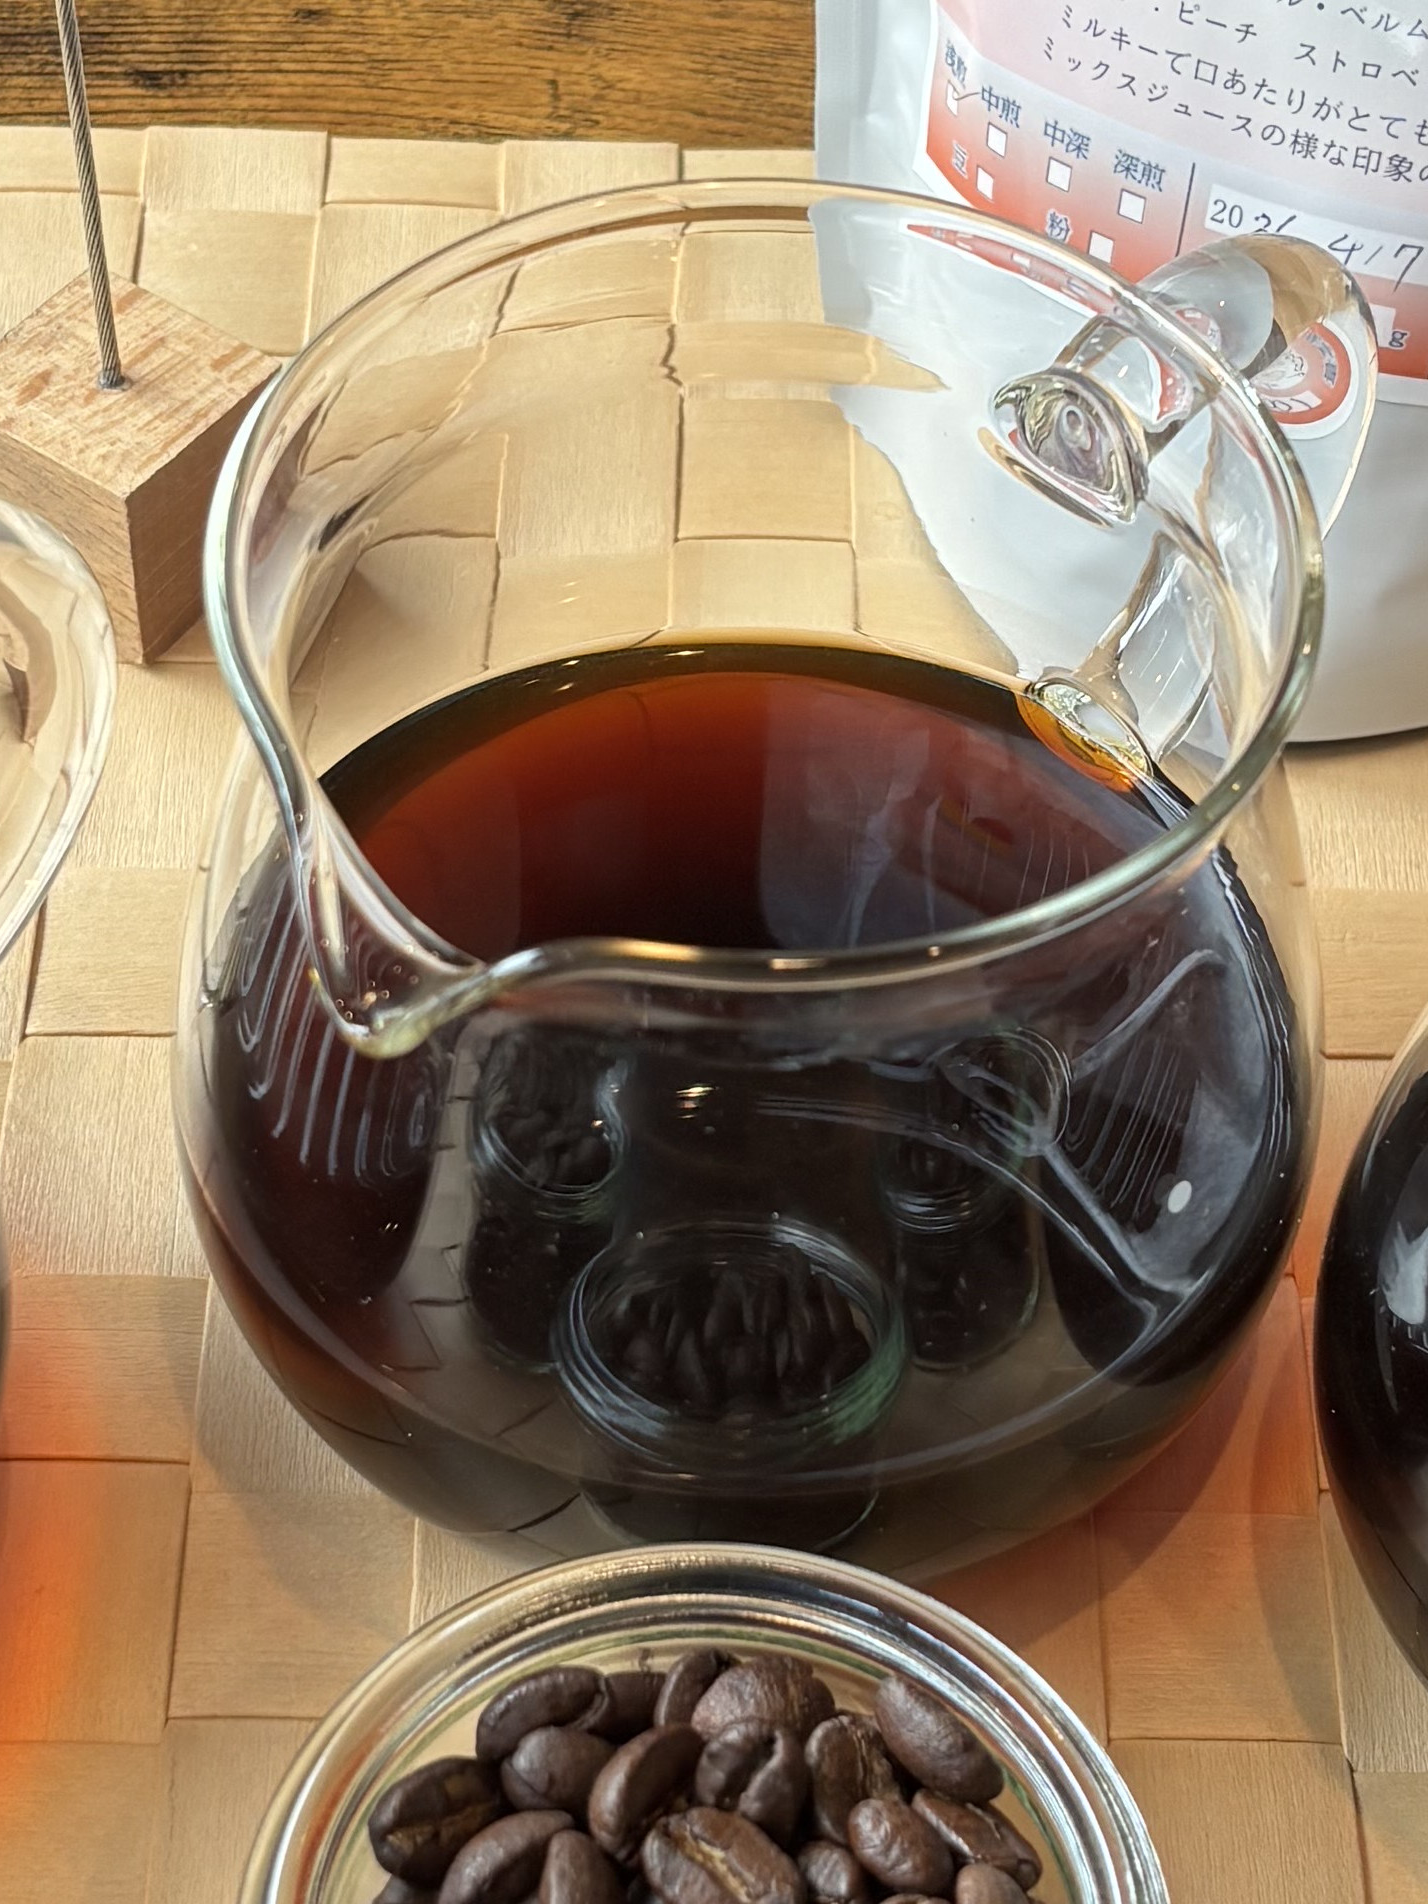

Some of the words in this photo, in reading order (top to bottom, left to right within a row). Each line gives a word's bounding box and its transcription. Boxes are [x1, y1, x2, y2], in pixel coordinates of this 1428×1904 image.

[981, 84, 1022, 128] 中煎
[1044, 119, 1091, 160] 中深
[1113, 149, 1166, 192] 深煎
[1388, 330, 1408, 348] g
